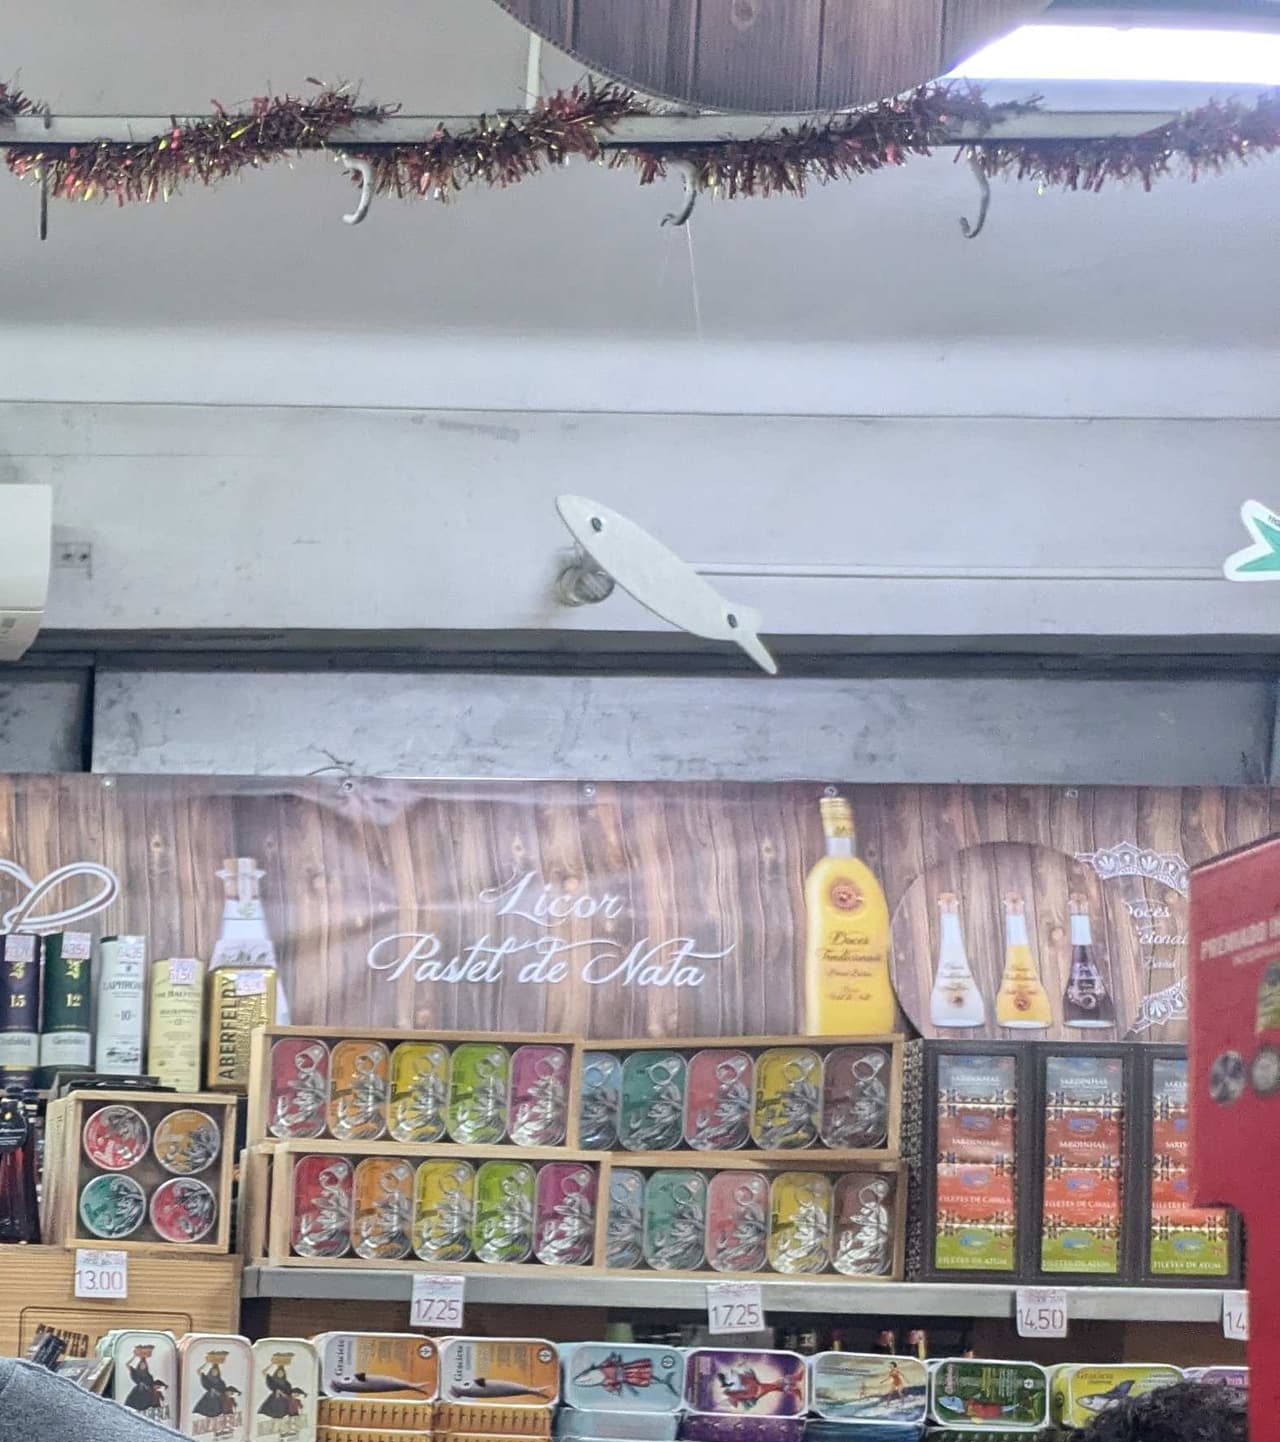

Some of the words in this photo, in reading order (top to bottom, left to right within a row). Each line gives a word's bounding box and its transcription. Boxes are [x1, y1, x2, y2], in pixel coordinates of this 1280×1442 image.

[479, 869, 624, 927] Licor
[366, 931, 529, 984] Pastel
[582, 936, 737, 988] Nata
[9, 993, 26, 1008] 15
[65, 992, 81, 1008] 12
[218, 976, 238, 1080] ABERFELDY
[413, 1298, 461, 1321] 17,25
[711, 1304, 759, 1326] 17,25
[1017, 1308, 1065, 1330] 14,50
